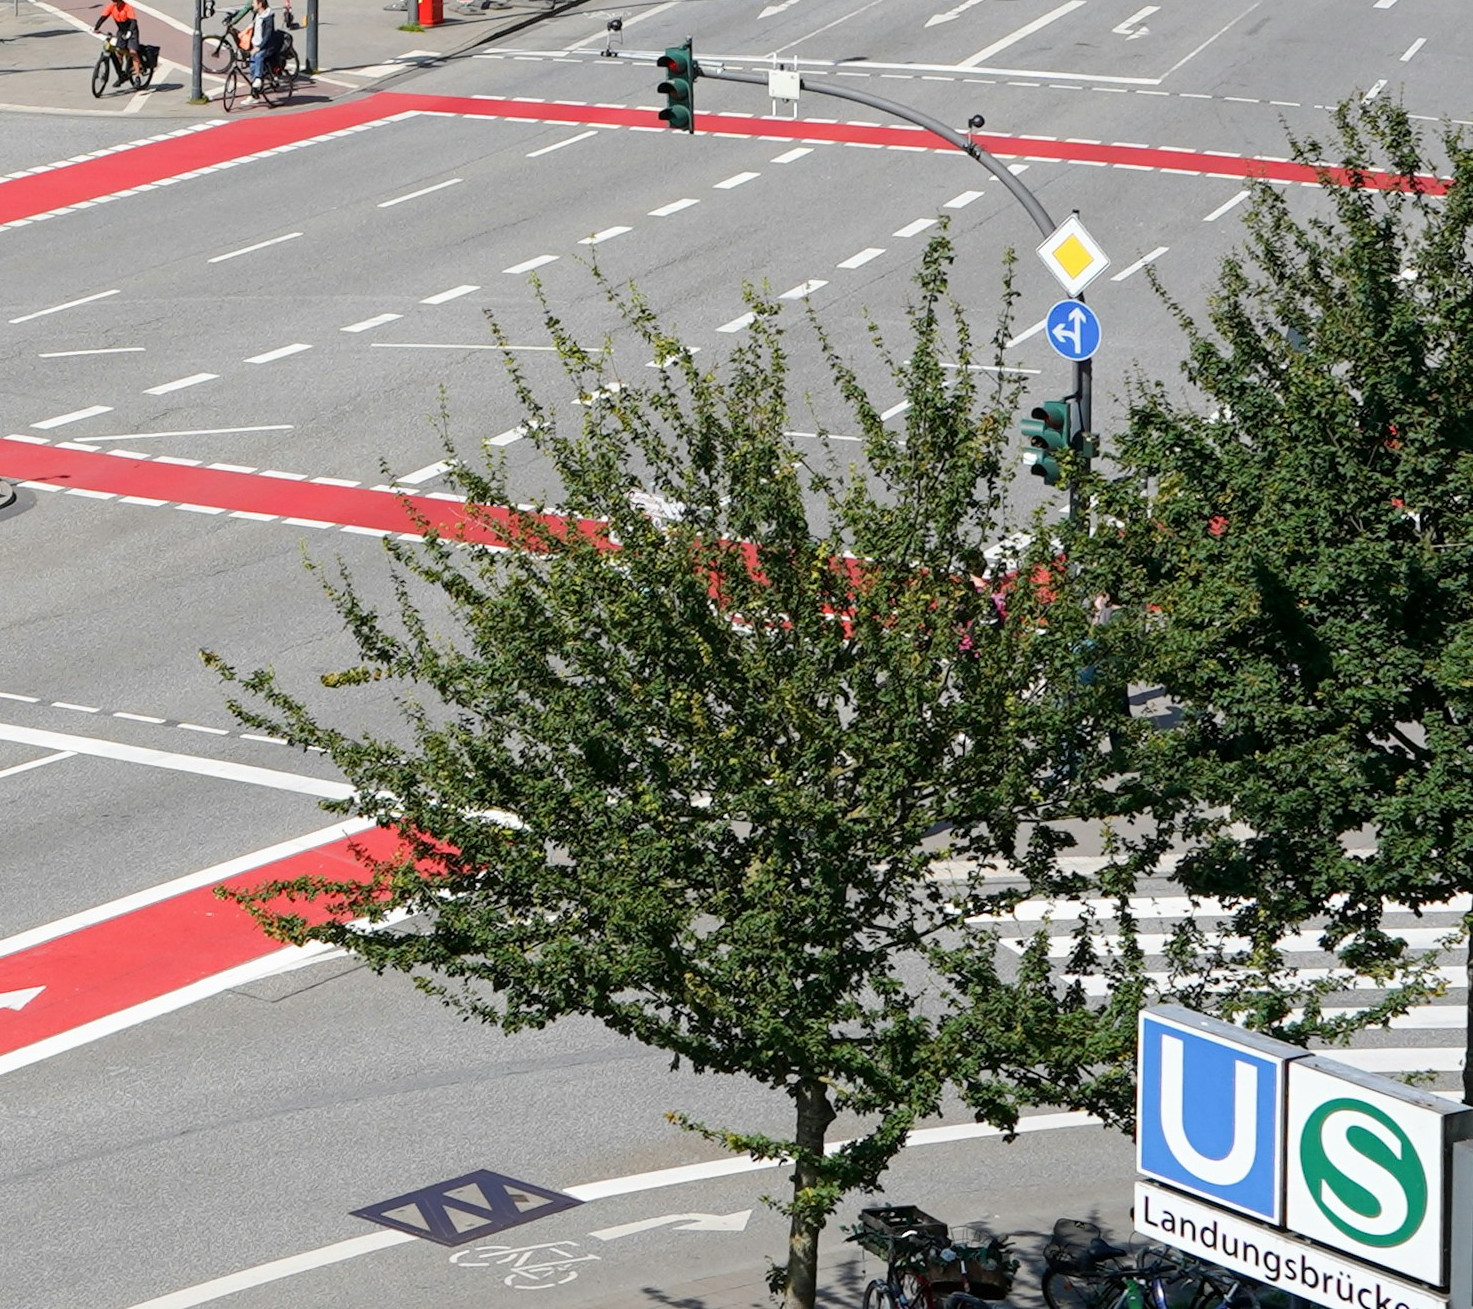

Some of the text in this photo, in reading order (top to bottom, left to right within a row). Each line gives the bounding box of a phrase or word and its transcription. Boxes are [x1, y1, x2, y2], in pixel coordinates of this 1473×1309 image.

[1160, 1033, 1411, 1237] U S
[1143, 1195, 1423, 1309] Landungsbrücke
